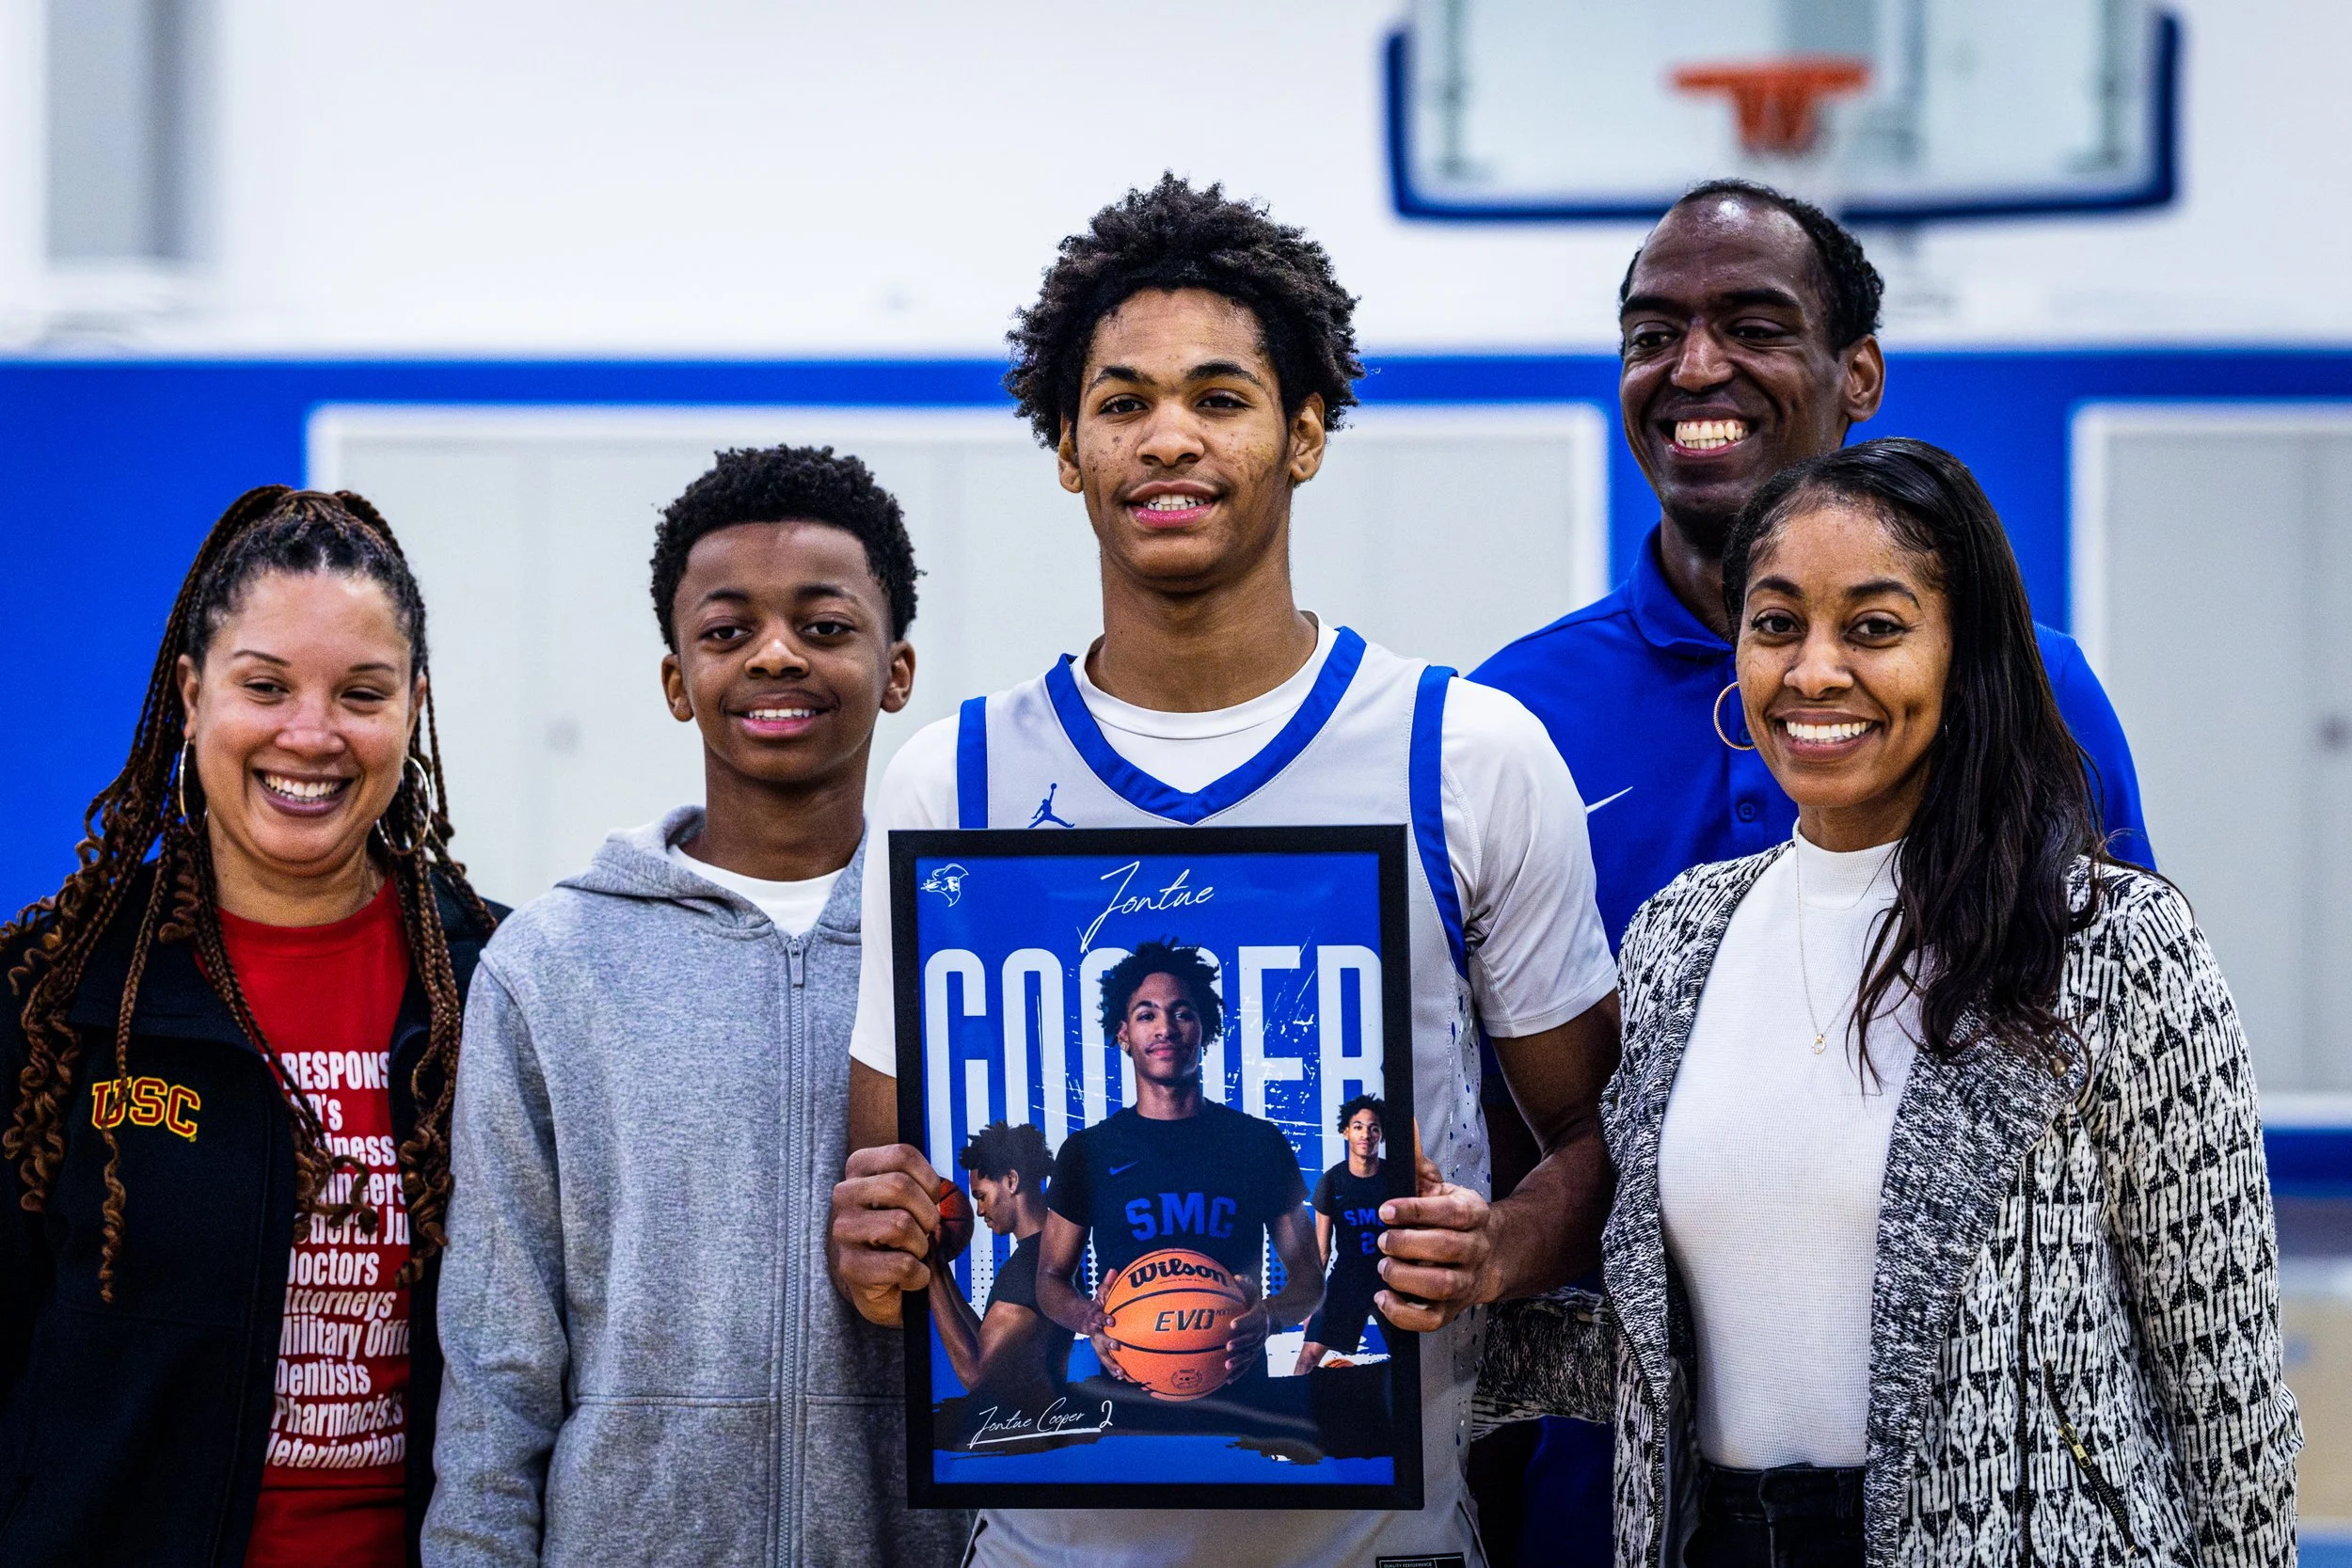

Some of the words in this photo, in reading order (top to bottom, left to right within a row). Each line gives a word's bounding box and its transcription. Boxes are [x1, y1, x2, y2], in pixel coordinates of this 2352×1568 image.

[1080, 861, 1216, 953] Jontue
[92, 1076, 201, 1138] USC
[1124, 1192, 1237, 1241] SMC
[1343, 1208, 1386, 1227] SM
[1128, 1258, 1229, 1289] Wilson
[1154, 1308, 1216, 1332] EVO
[274, 1358, 372, 1397] Dentists
[1037, 1396, 1085, 1432] Cooper
[1099, 1400, 1114, 1428] 2
